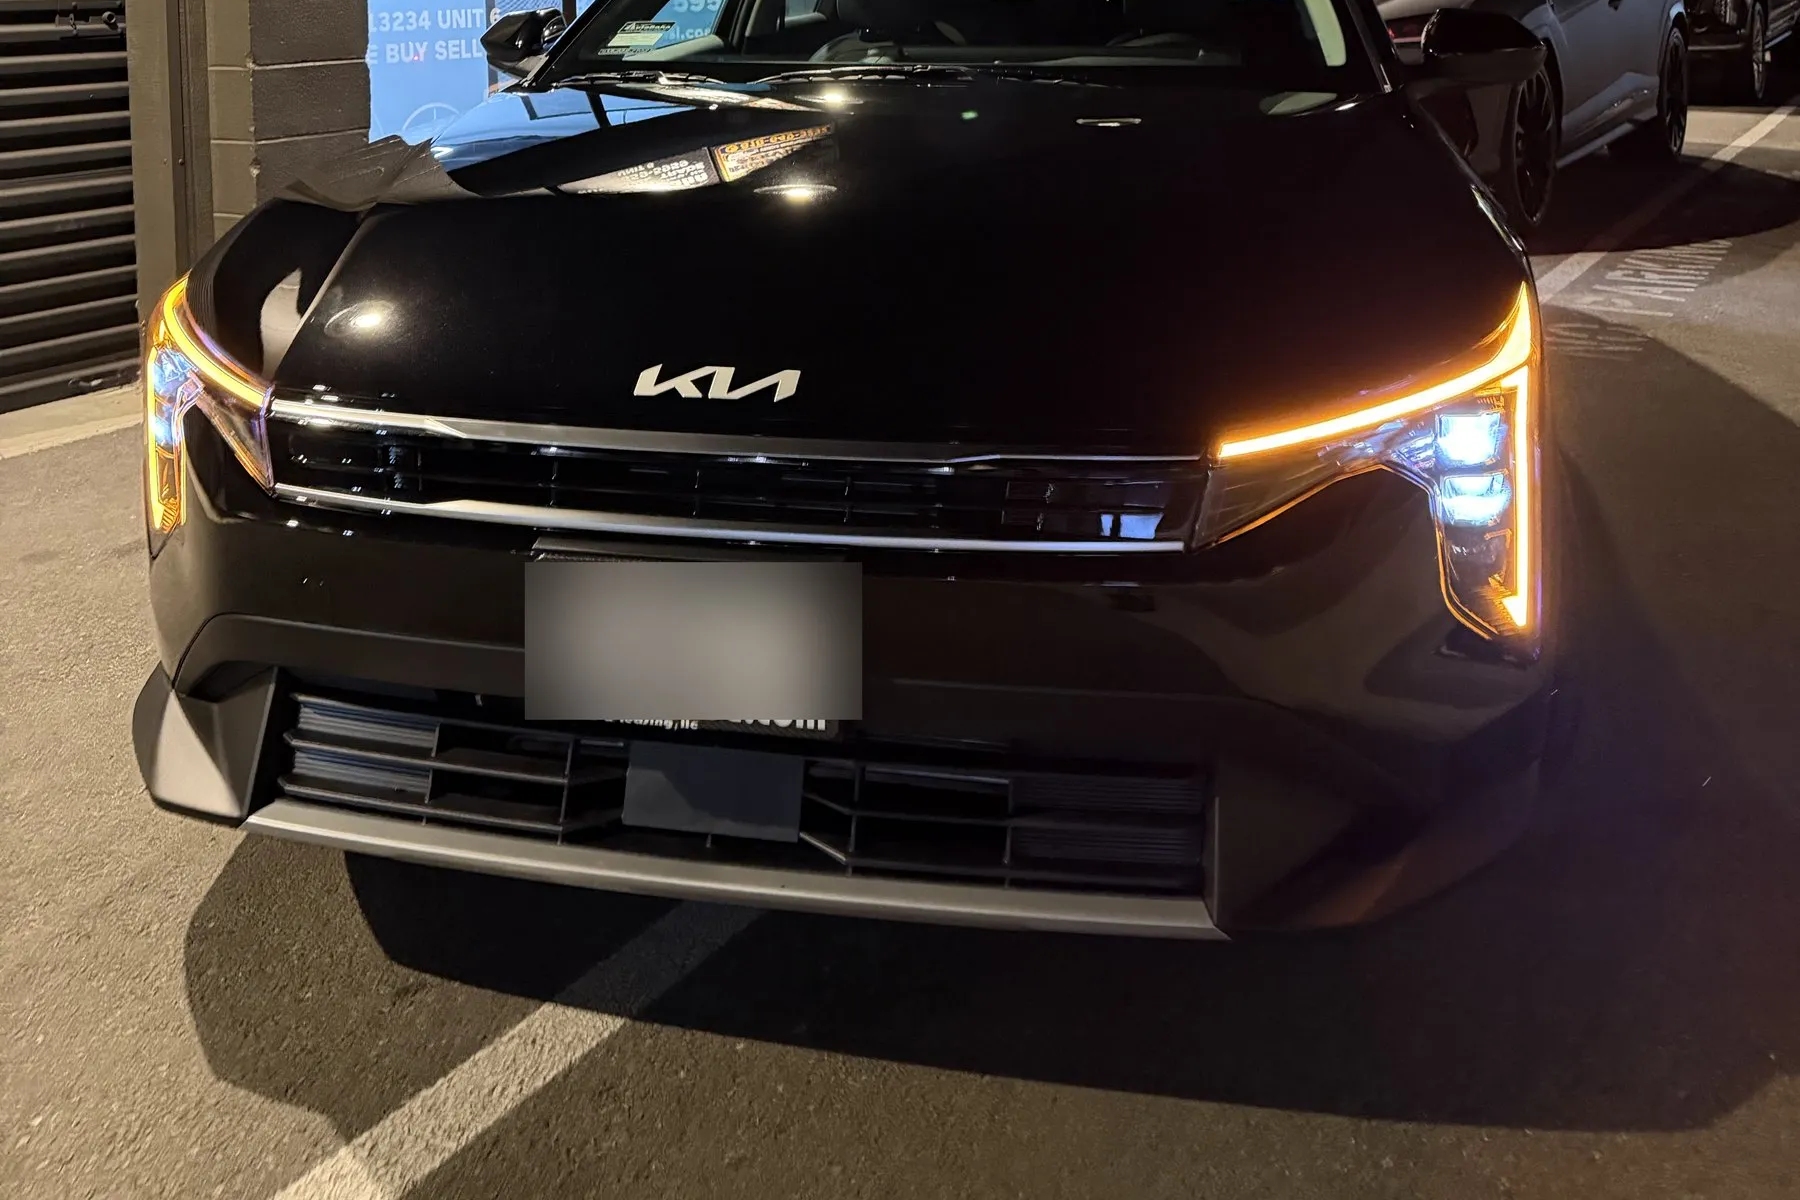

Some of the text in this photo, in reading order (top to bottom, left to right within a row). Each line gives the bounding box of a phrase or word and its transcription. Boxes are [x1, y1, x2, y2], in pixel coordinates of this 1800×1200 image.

[437, 8, 484, 29] UNIT
[368, 39, 483, 64] E BUY SELL
